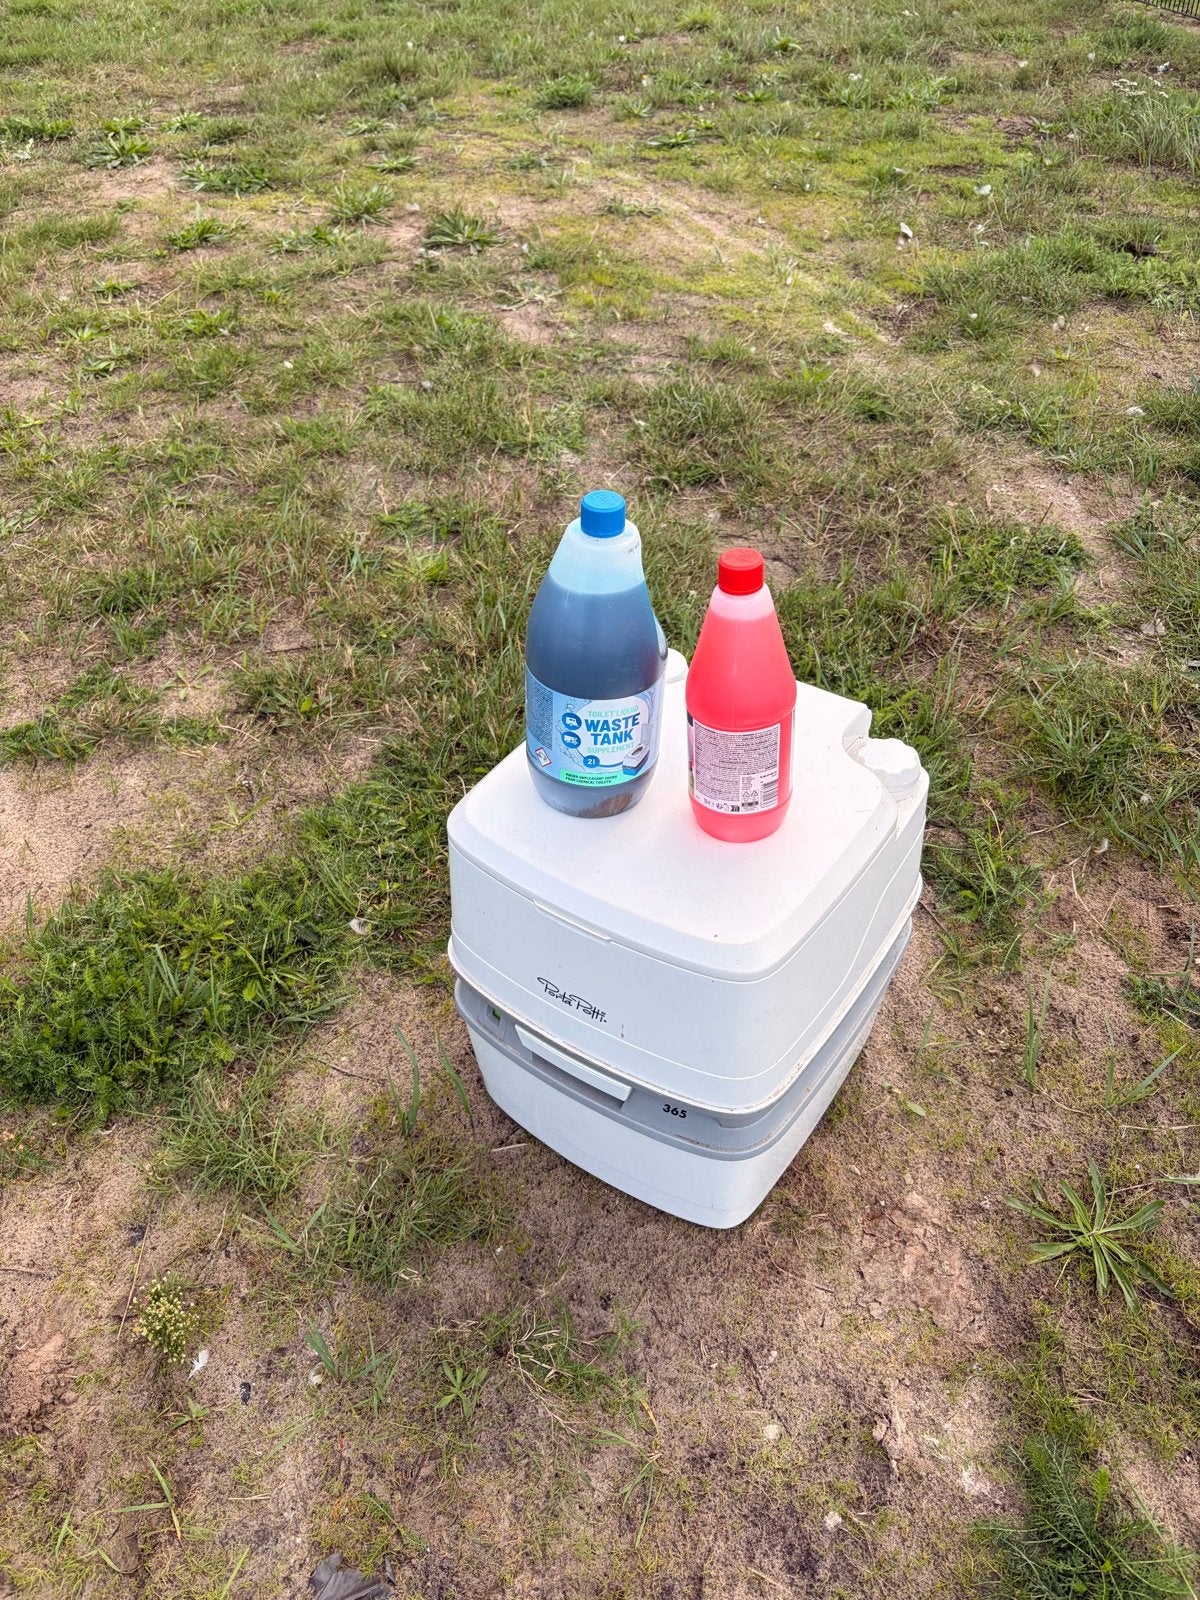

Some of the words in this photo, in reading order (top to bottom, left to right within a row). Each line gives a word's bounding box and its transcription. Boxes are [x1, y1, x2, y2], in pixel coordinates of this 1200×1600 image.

[588, 710, 614, 718] TOILET
[616, 705, 639, 717] LIQUID
[584, 712, 640, 733] WASTE
[591, 728, 634, 746] TANK
[587, 742, 634, 754] SUPPLEMENT
[537, 976, 573, 1006] Porta
[568, 994, 606, 1022] Potti
[662, 1103, 688, 1119] 365
